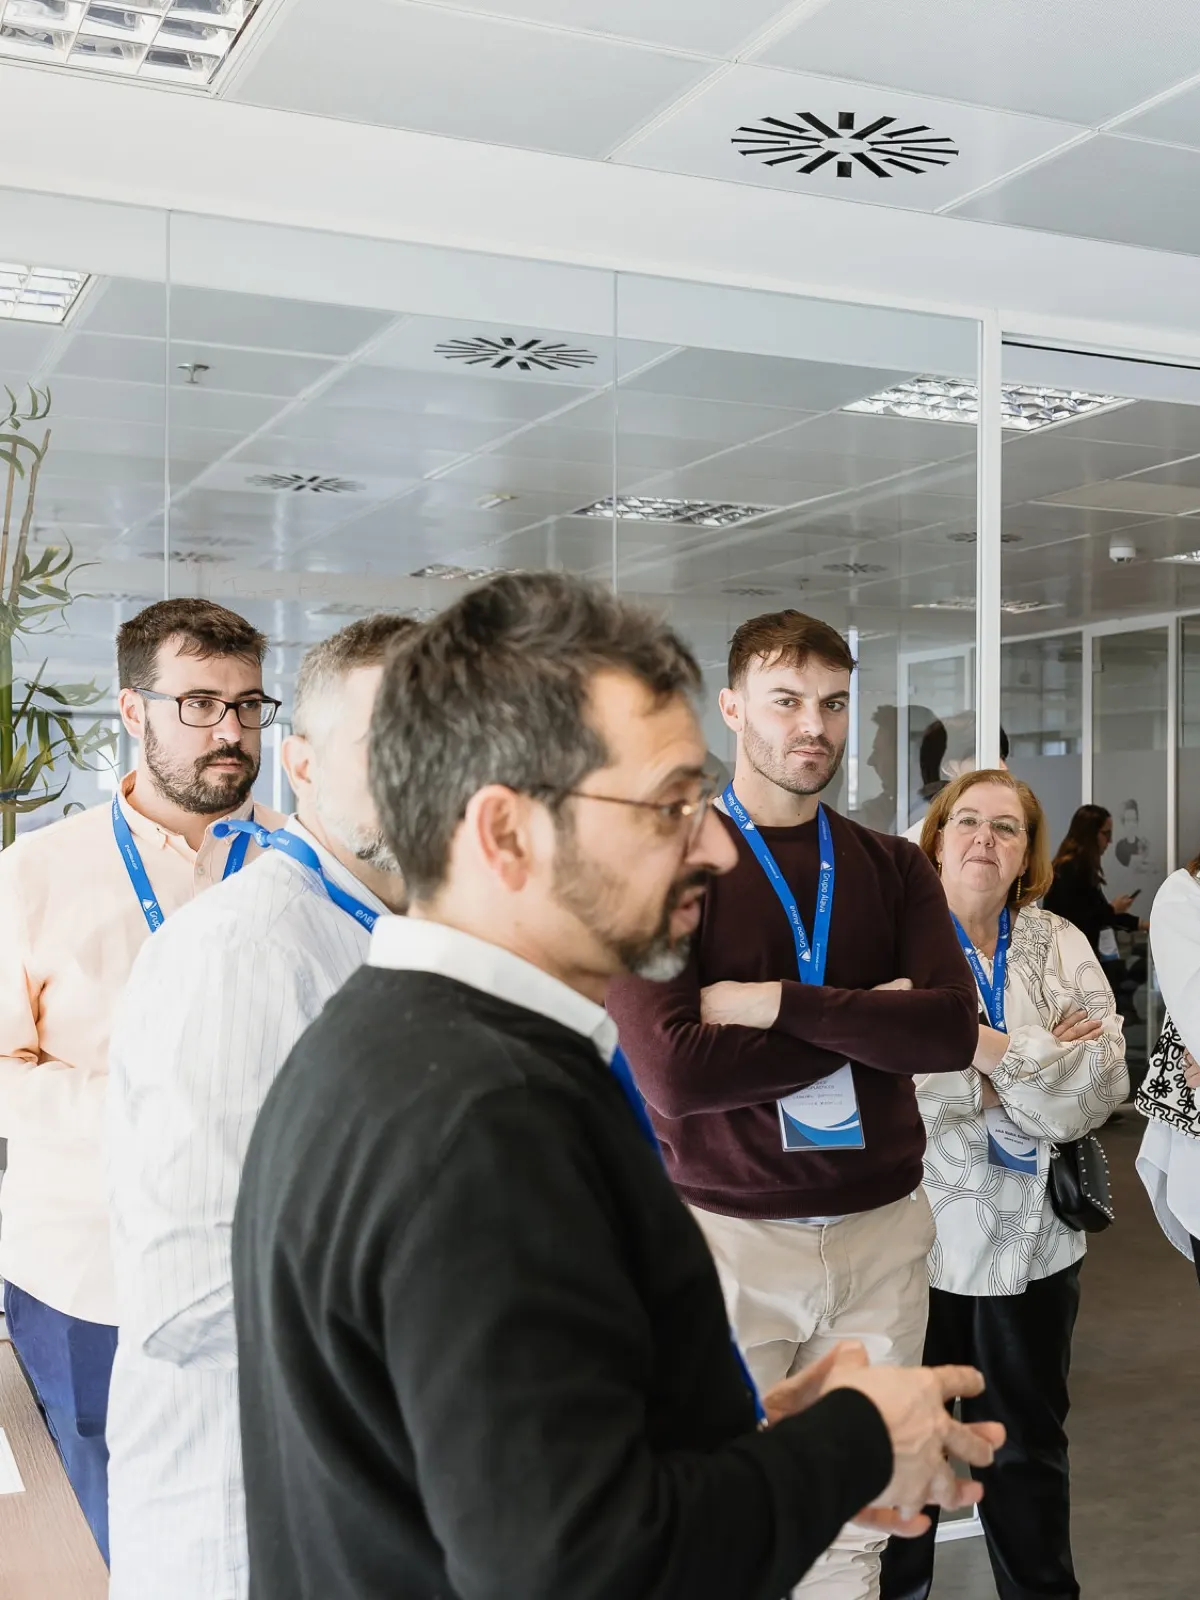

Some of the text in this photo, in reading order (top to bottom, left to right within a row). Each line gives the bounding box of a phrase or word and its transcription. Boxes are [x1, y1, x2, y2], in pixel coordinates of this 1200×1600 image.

[821, 872, 831, 893] Grupo
[149, 910, 162, 929] Grup
[797, 926, 806, 948] Grupo
